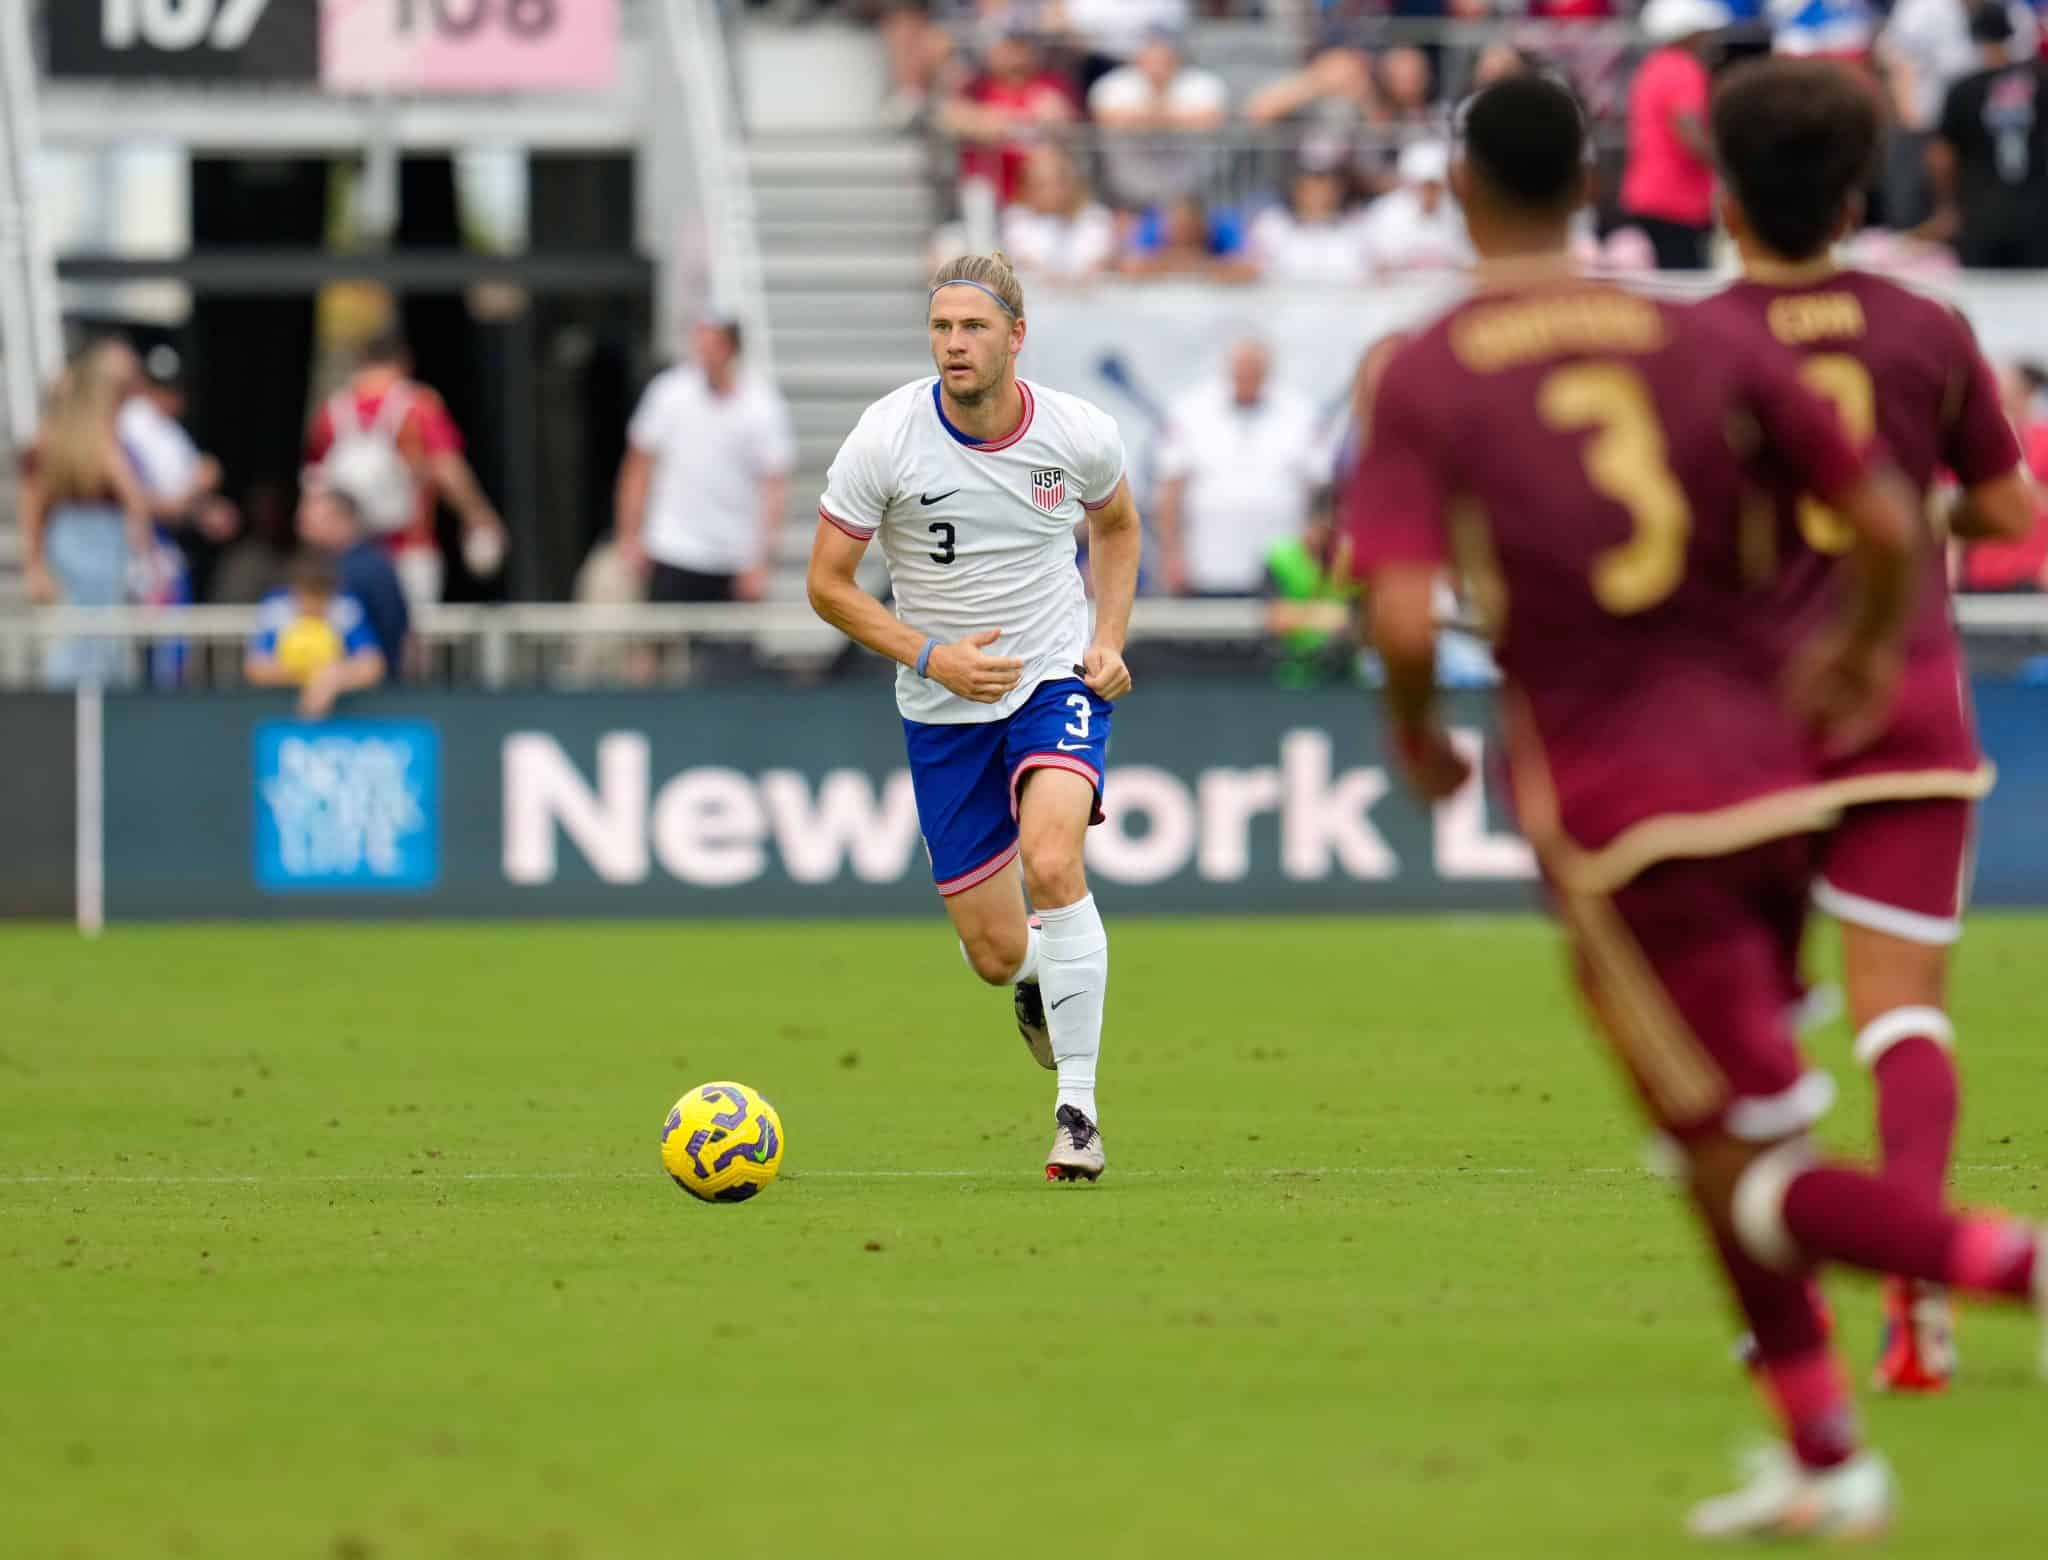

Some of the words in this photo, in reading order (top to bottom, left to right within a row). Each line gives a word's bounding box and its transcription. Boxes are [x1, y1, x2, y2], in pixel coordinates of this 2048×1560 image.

[1033, 470, 1062, 489] USA
[1535, 359, 1693, 615] 3
[928, 522, 956, 565] 3
[1064, 693, 1092, 738] 3
[502, 730, 921, 886] New
[1084, 728, 1398, 885] ork
